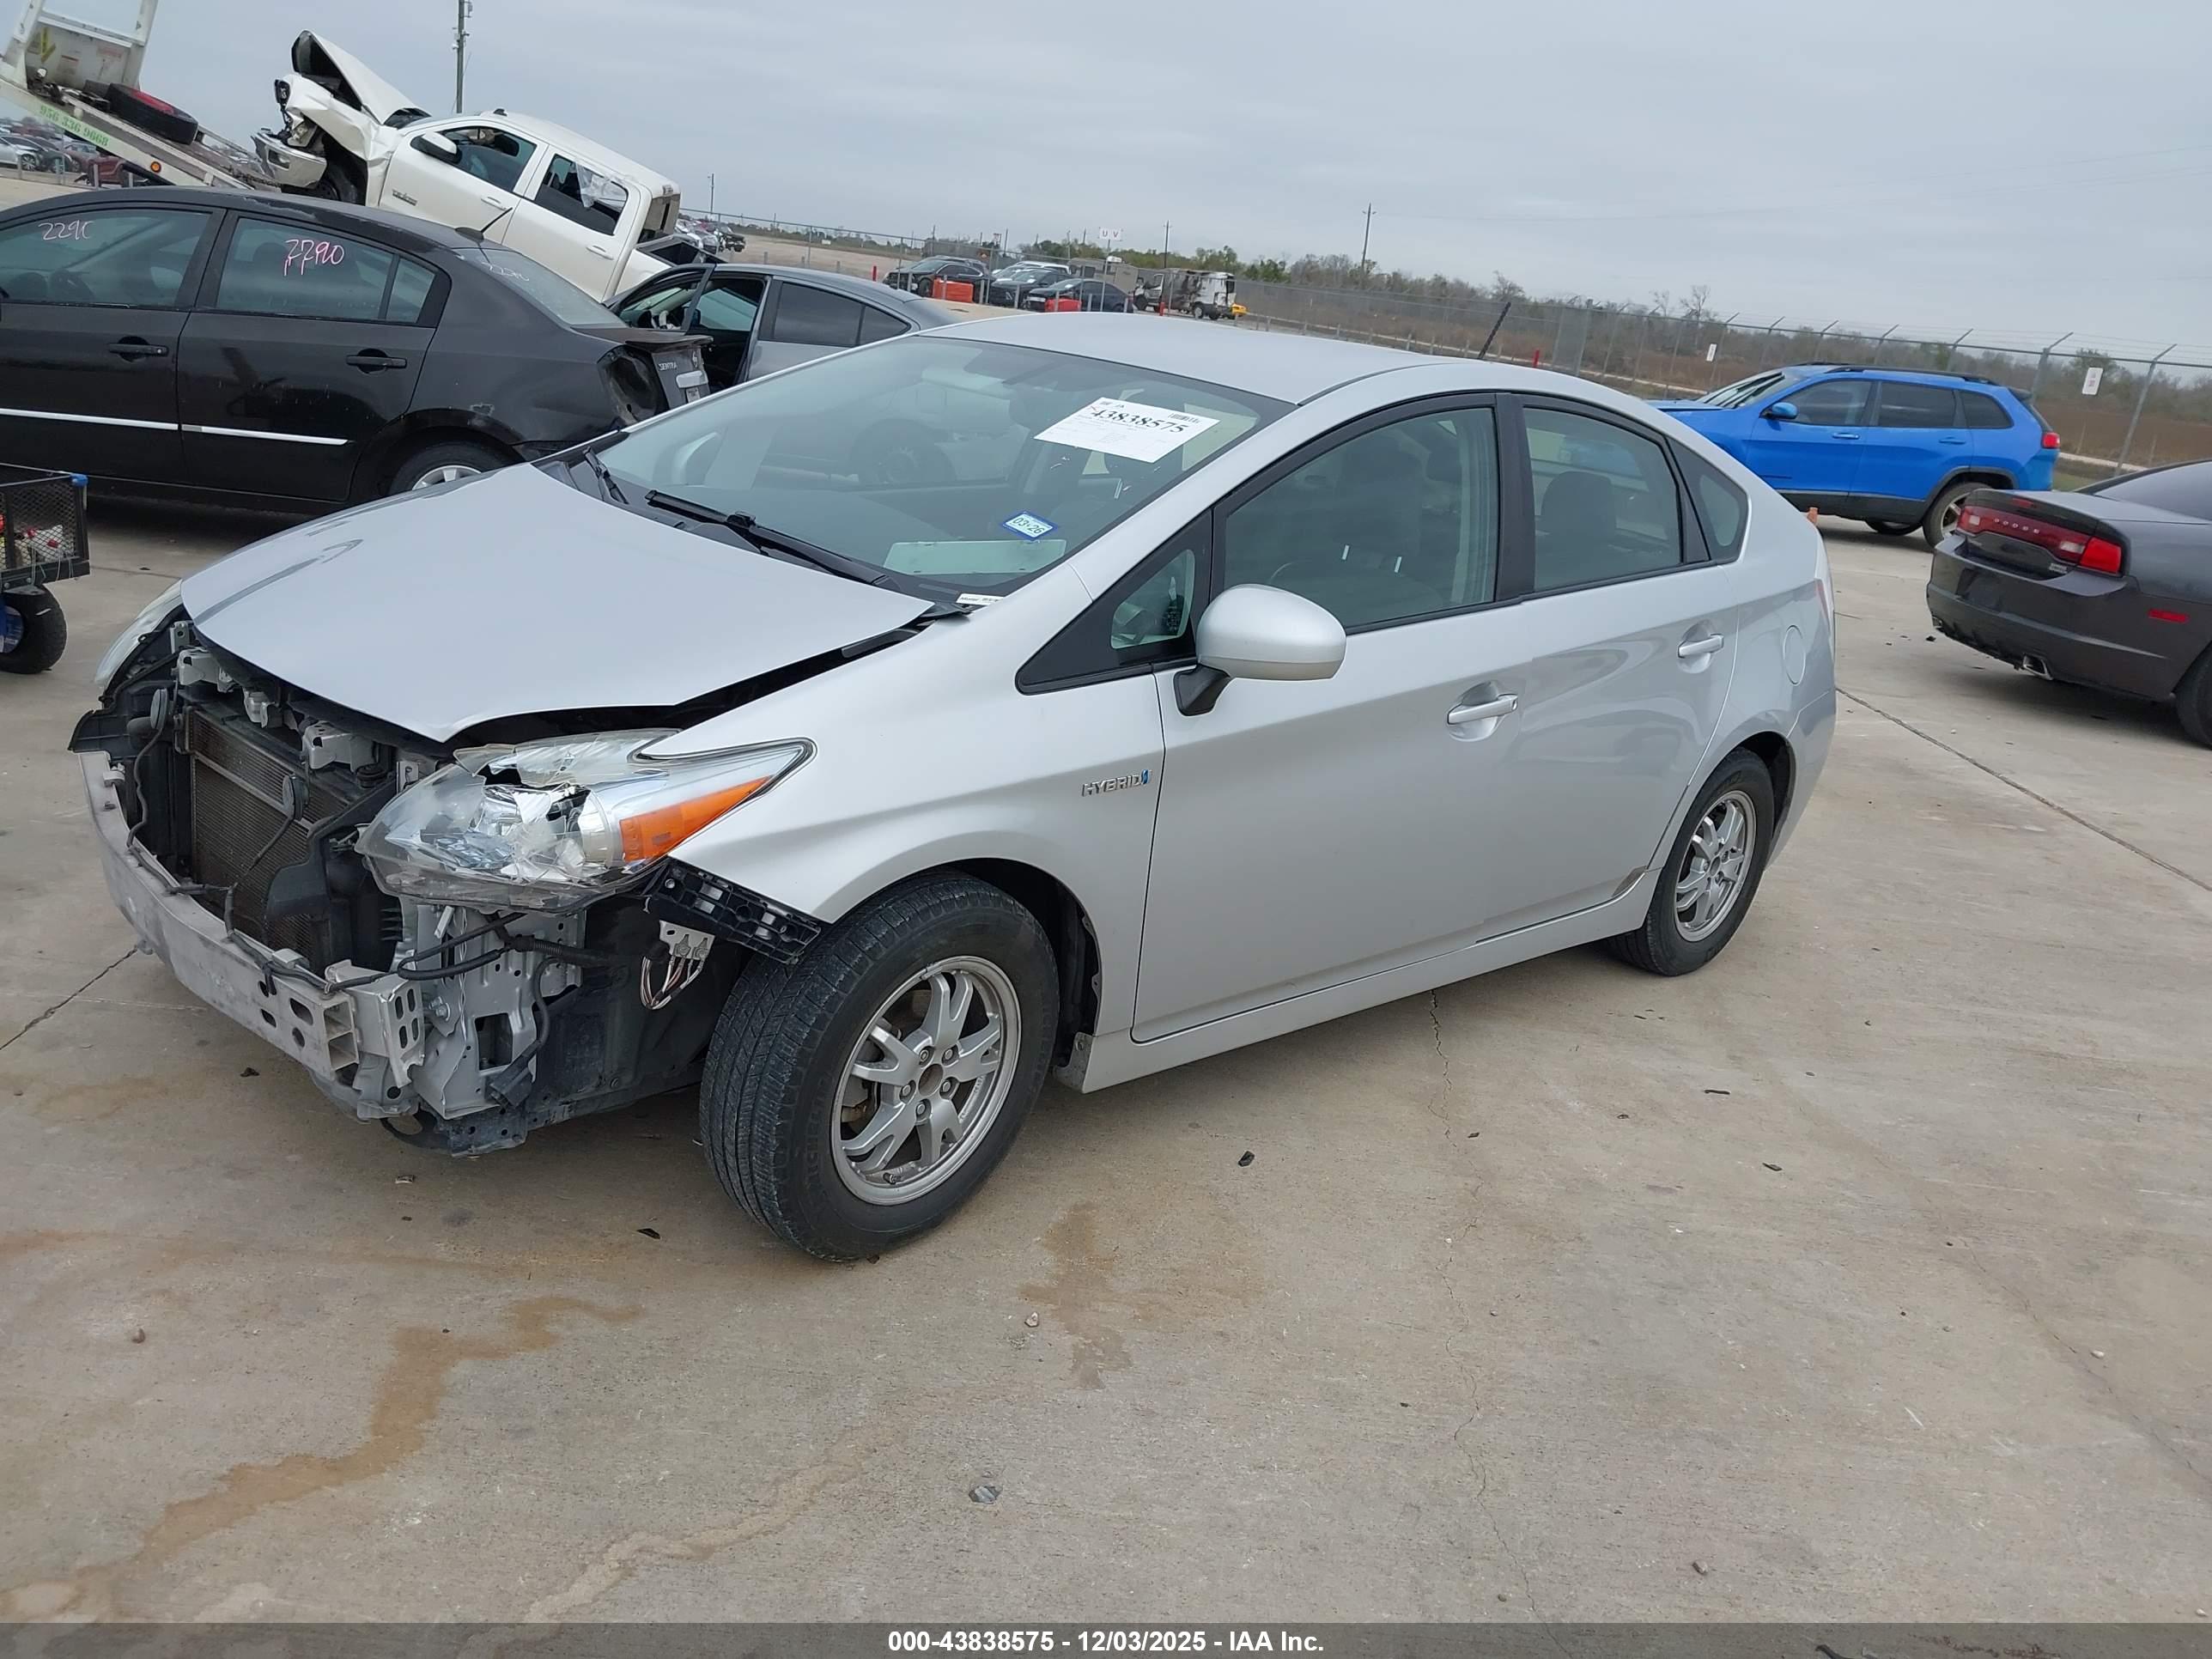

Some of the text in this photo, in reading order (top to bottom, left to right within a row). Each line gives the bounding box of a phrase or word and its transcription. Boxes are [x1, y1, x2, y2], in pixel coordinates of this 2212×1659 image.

[40, 104, 59, 121] 956
[62, 116, 82, 133] 336
[1091, 408, 1189, 434] 43838575
[1081, 774, 1141, 798] HYBRID
